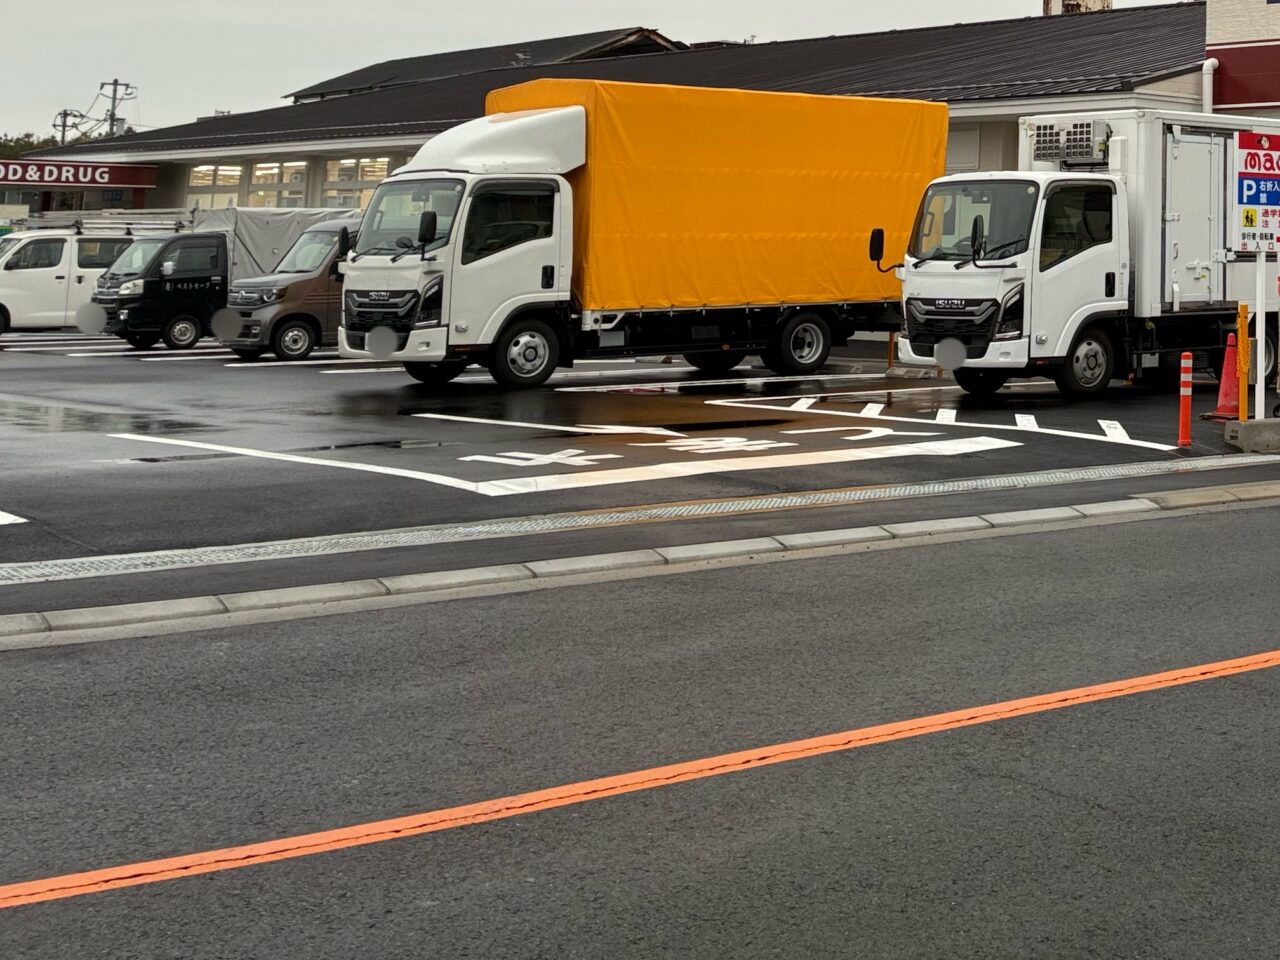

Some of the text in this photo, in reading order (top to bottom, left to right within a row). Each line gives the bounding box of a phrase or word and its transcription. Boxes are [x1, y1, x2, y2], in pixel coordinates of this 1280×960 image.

[1243, 179, 1257, 203] P
[1241, 242, 1275, 251] 出入口
[935, 299, 965, 309] ISUZU
